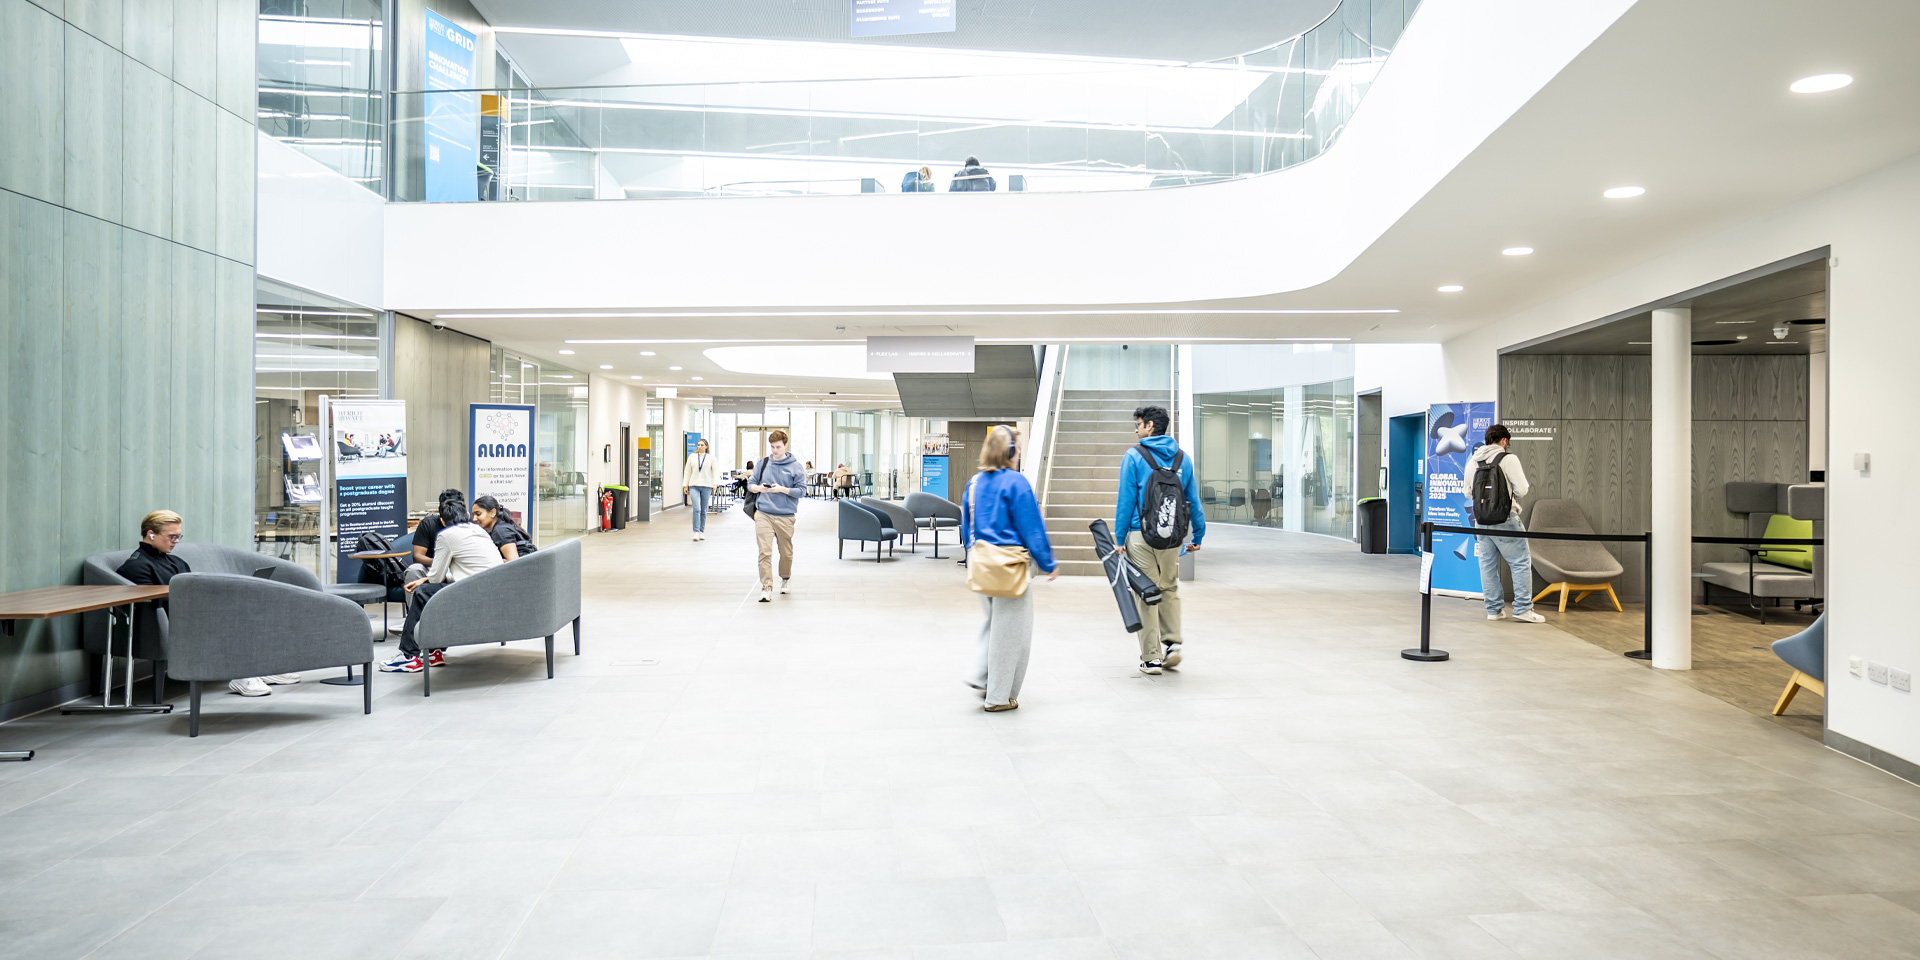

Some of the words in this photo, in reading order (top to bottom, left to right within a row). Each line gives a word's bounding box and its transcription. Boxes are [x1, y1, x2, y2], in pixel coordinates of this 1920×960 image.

[446, 28, 474, 52] GRID
[429, 50, 469, 77] INNOVATION
[429, 60, 468, 85] CHALLENGE
[478, 443, 526, 458] ALANA
